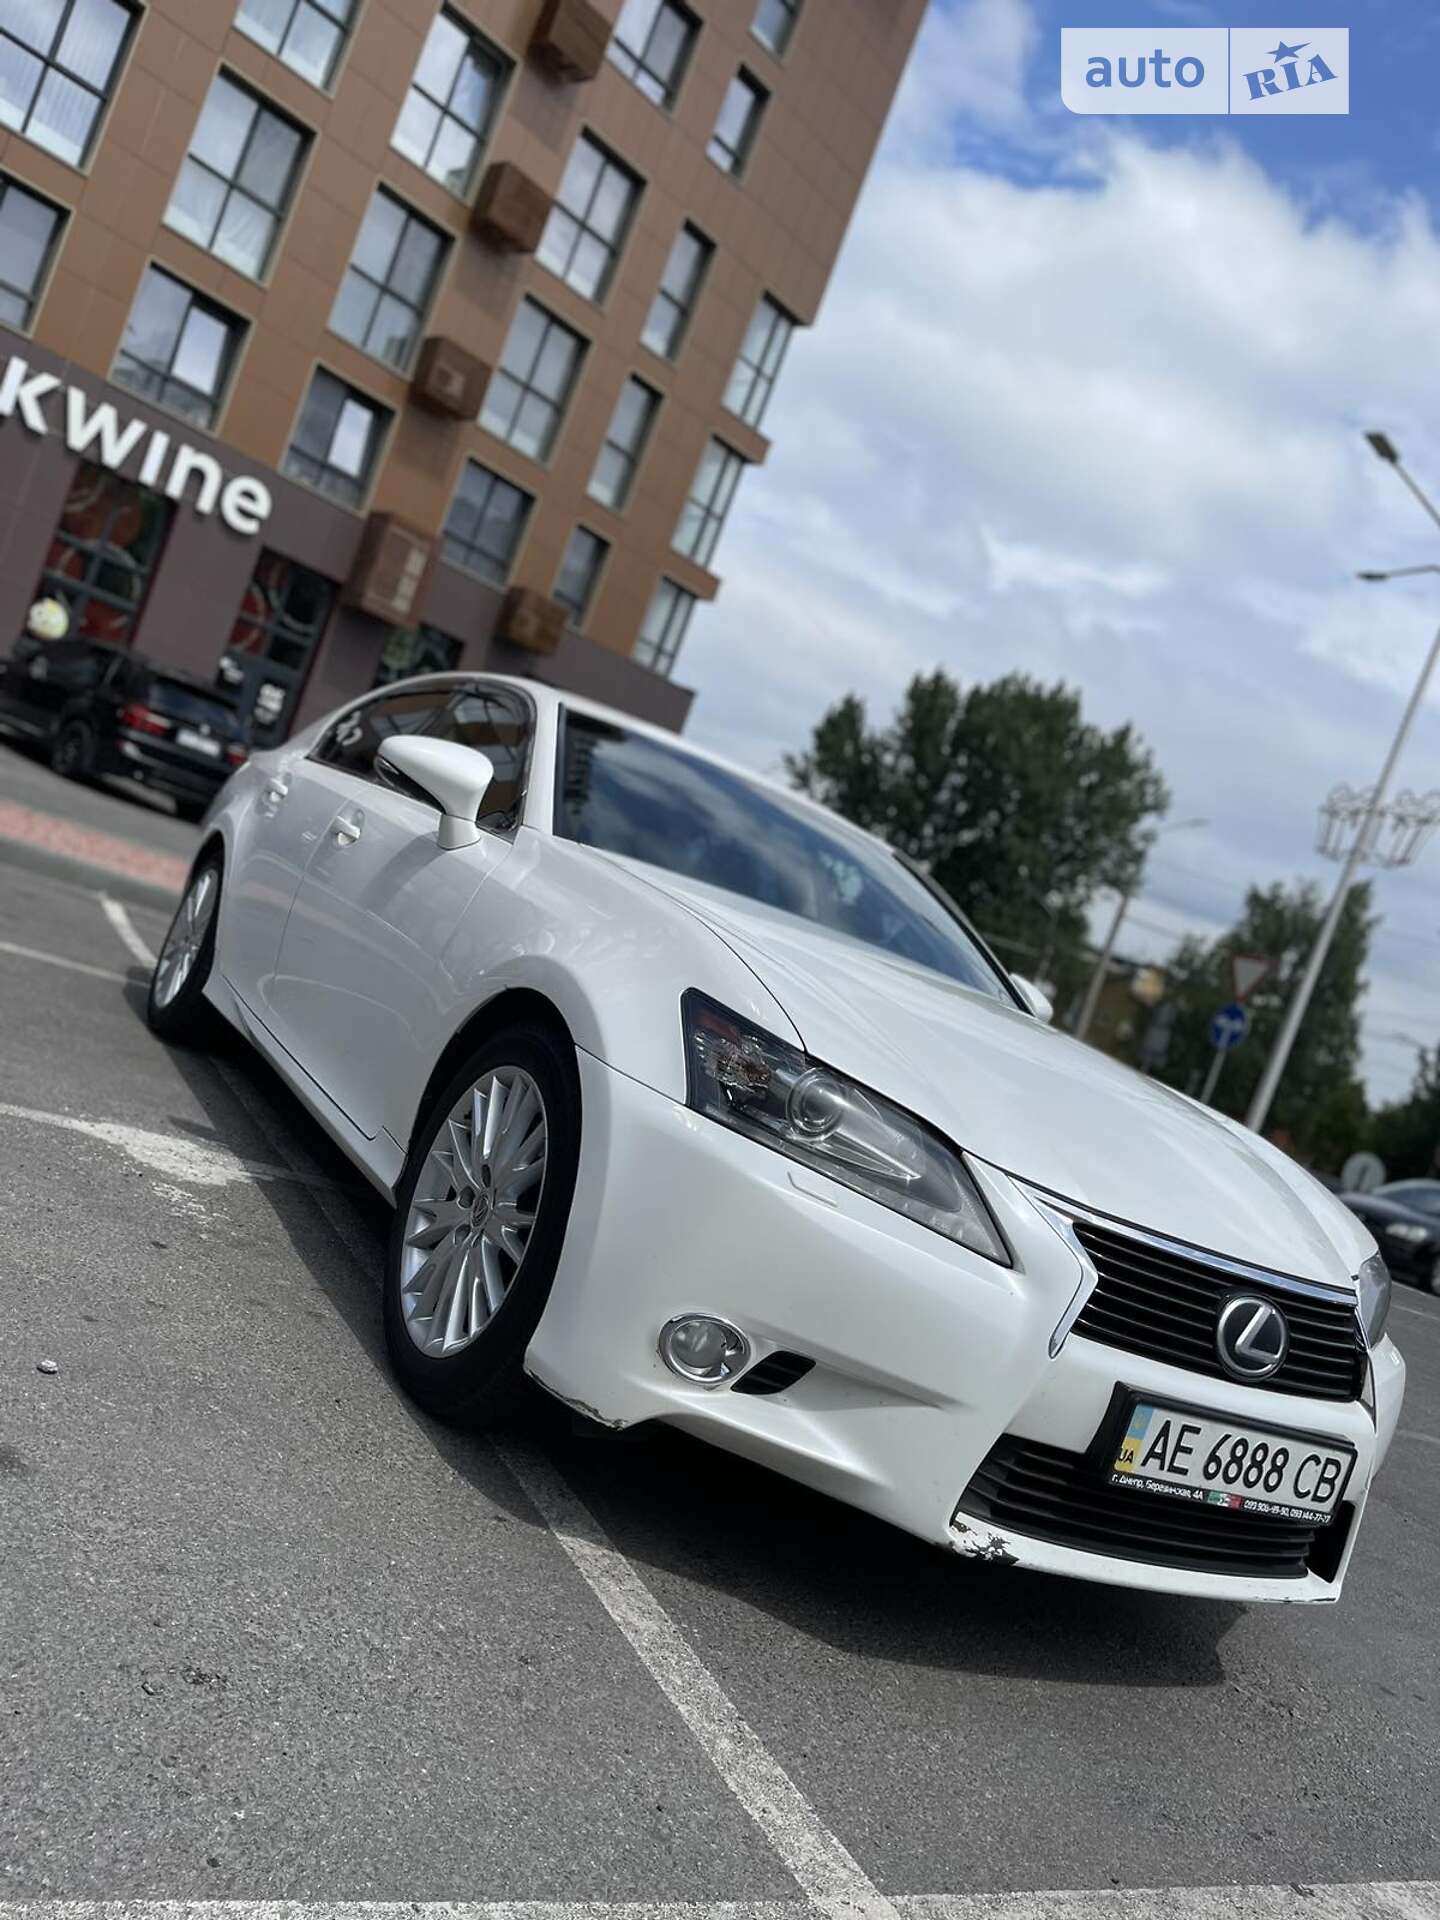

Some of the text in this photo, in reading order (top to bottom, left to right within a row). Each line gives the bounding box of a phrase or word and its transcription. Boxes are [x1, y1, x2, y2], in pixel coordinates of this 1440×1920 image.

[1140, 1419, 1342, 1503] AE 6888 CB
